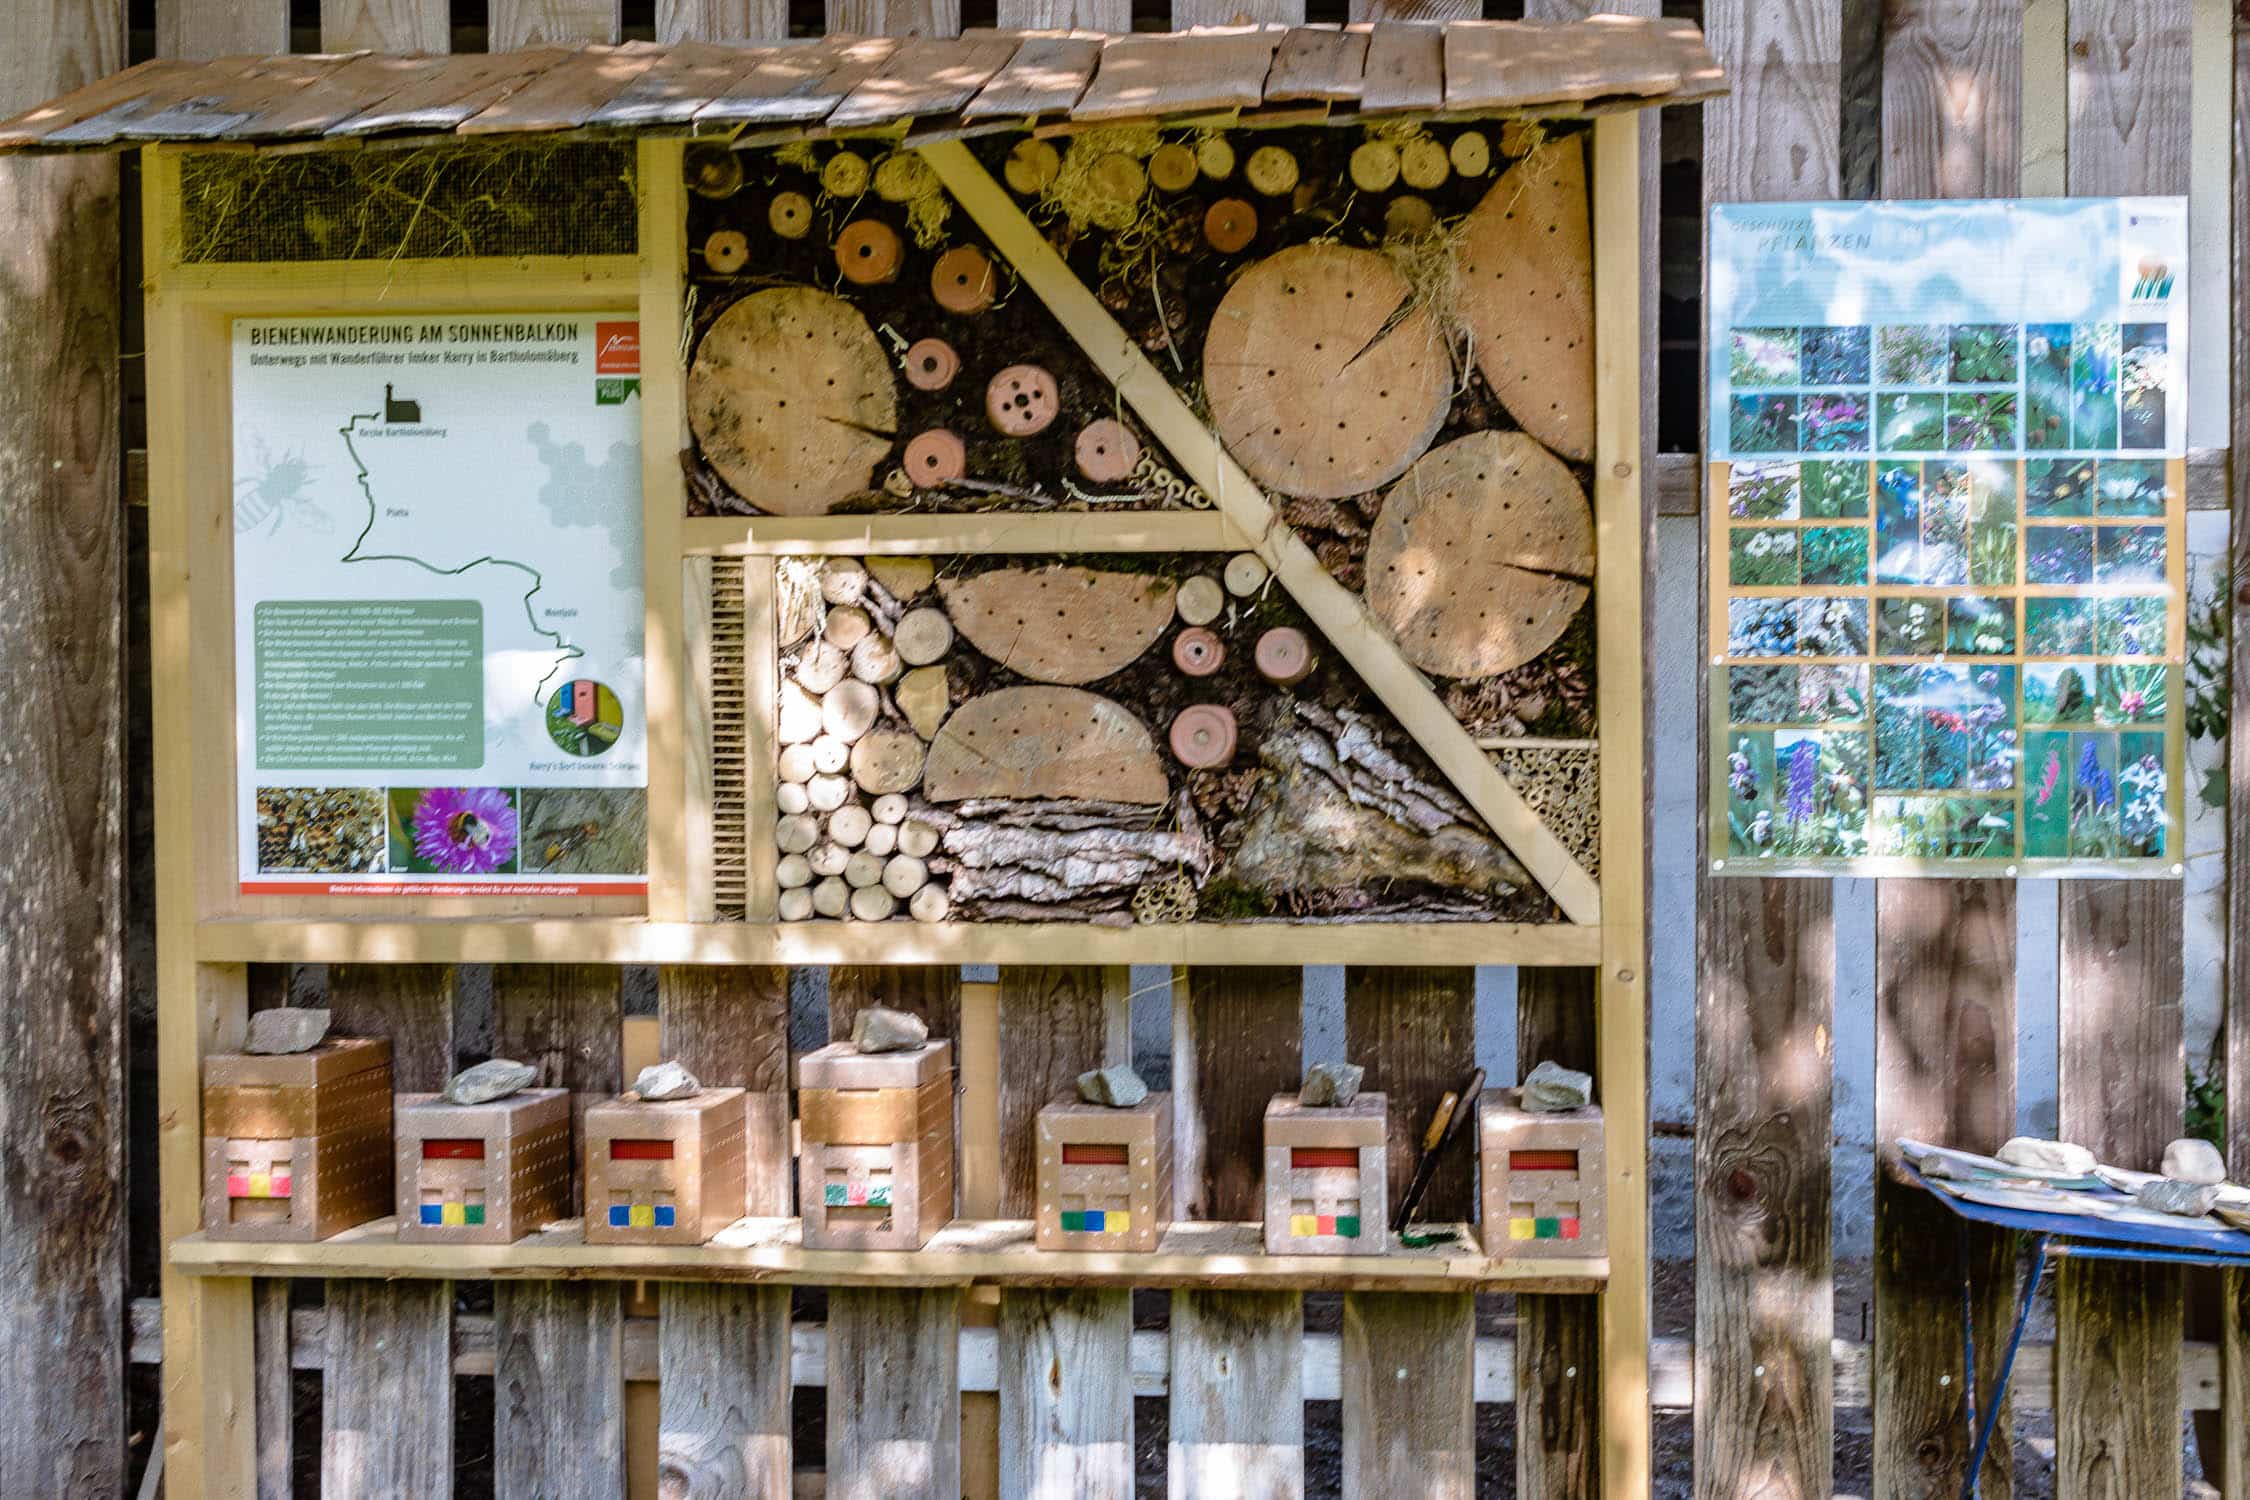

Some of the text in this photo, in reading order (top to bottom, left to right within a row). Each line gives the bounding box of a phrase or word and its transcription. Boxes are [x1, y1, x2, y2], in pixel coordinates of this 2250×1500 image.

[250, 322, 578, 345] BIENENWANDERUNG AM SONNENBALKON
[250, 352, 307, 368] Unterwegs
[309, 352, 327, 365] mit
[330, 351, 405, 366] Wanderführer
[408, 351, 441, 364] Imker
[476, 350, 488, 363] in
[490, 347, 579, 364] Bartholomäberg
